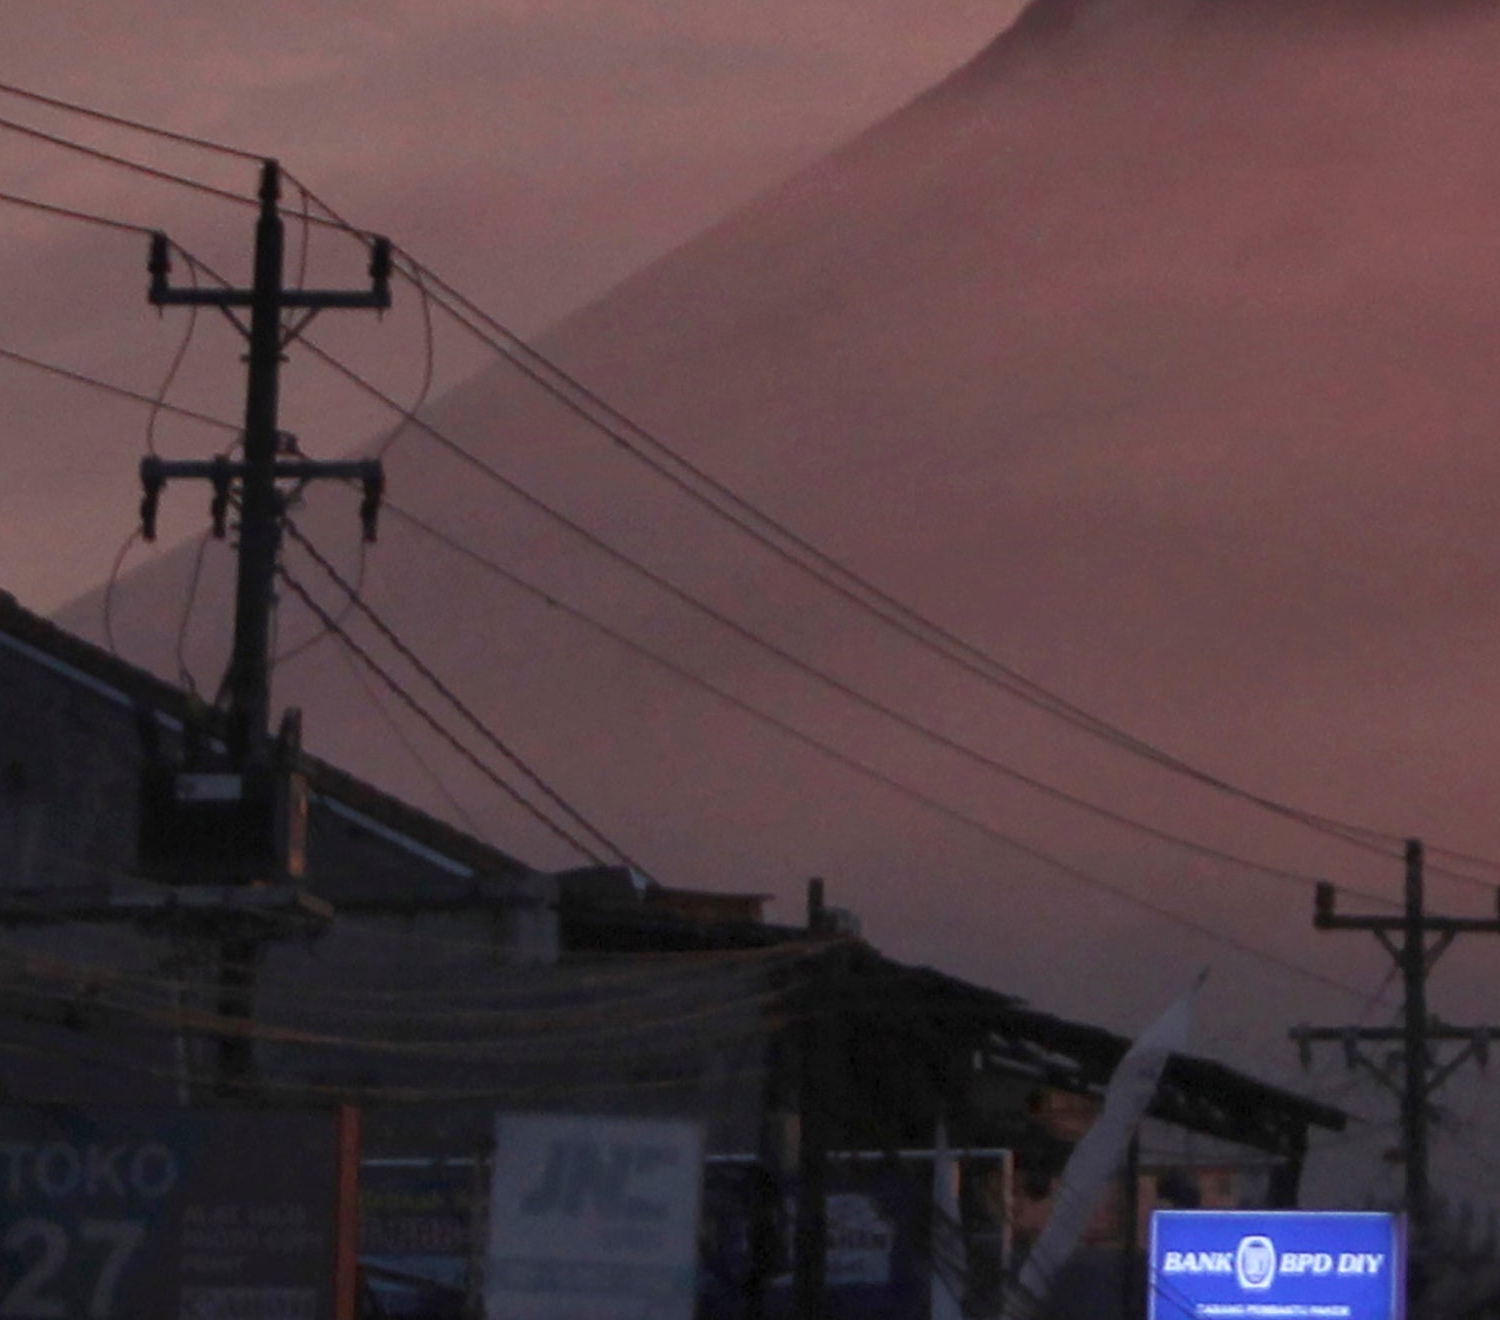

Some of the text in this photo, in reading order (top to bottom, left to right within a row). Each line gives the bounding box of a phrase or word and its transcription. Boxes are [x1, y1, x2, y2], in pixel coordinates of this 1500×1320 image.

[1161, 1251, 1385, 1276] BANK BPD DIY
